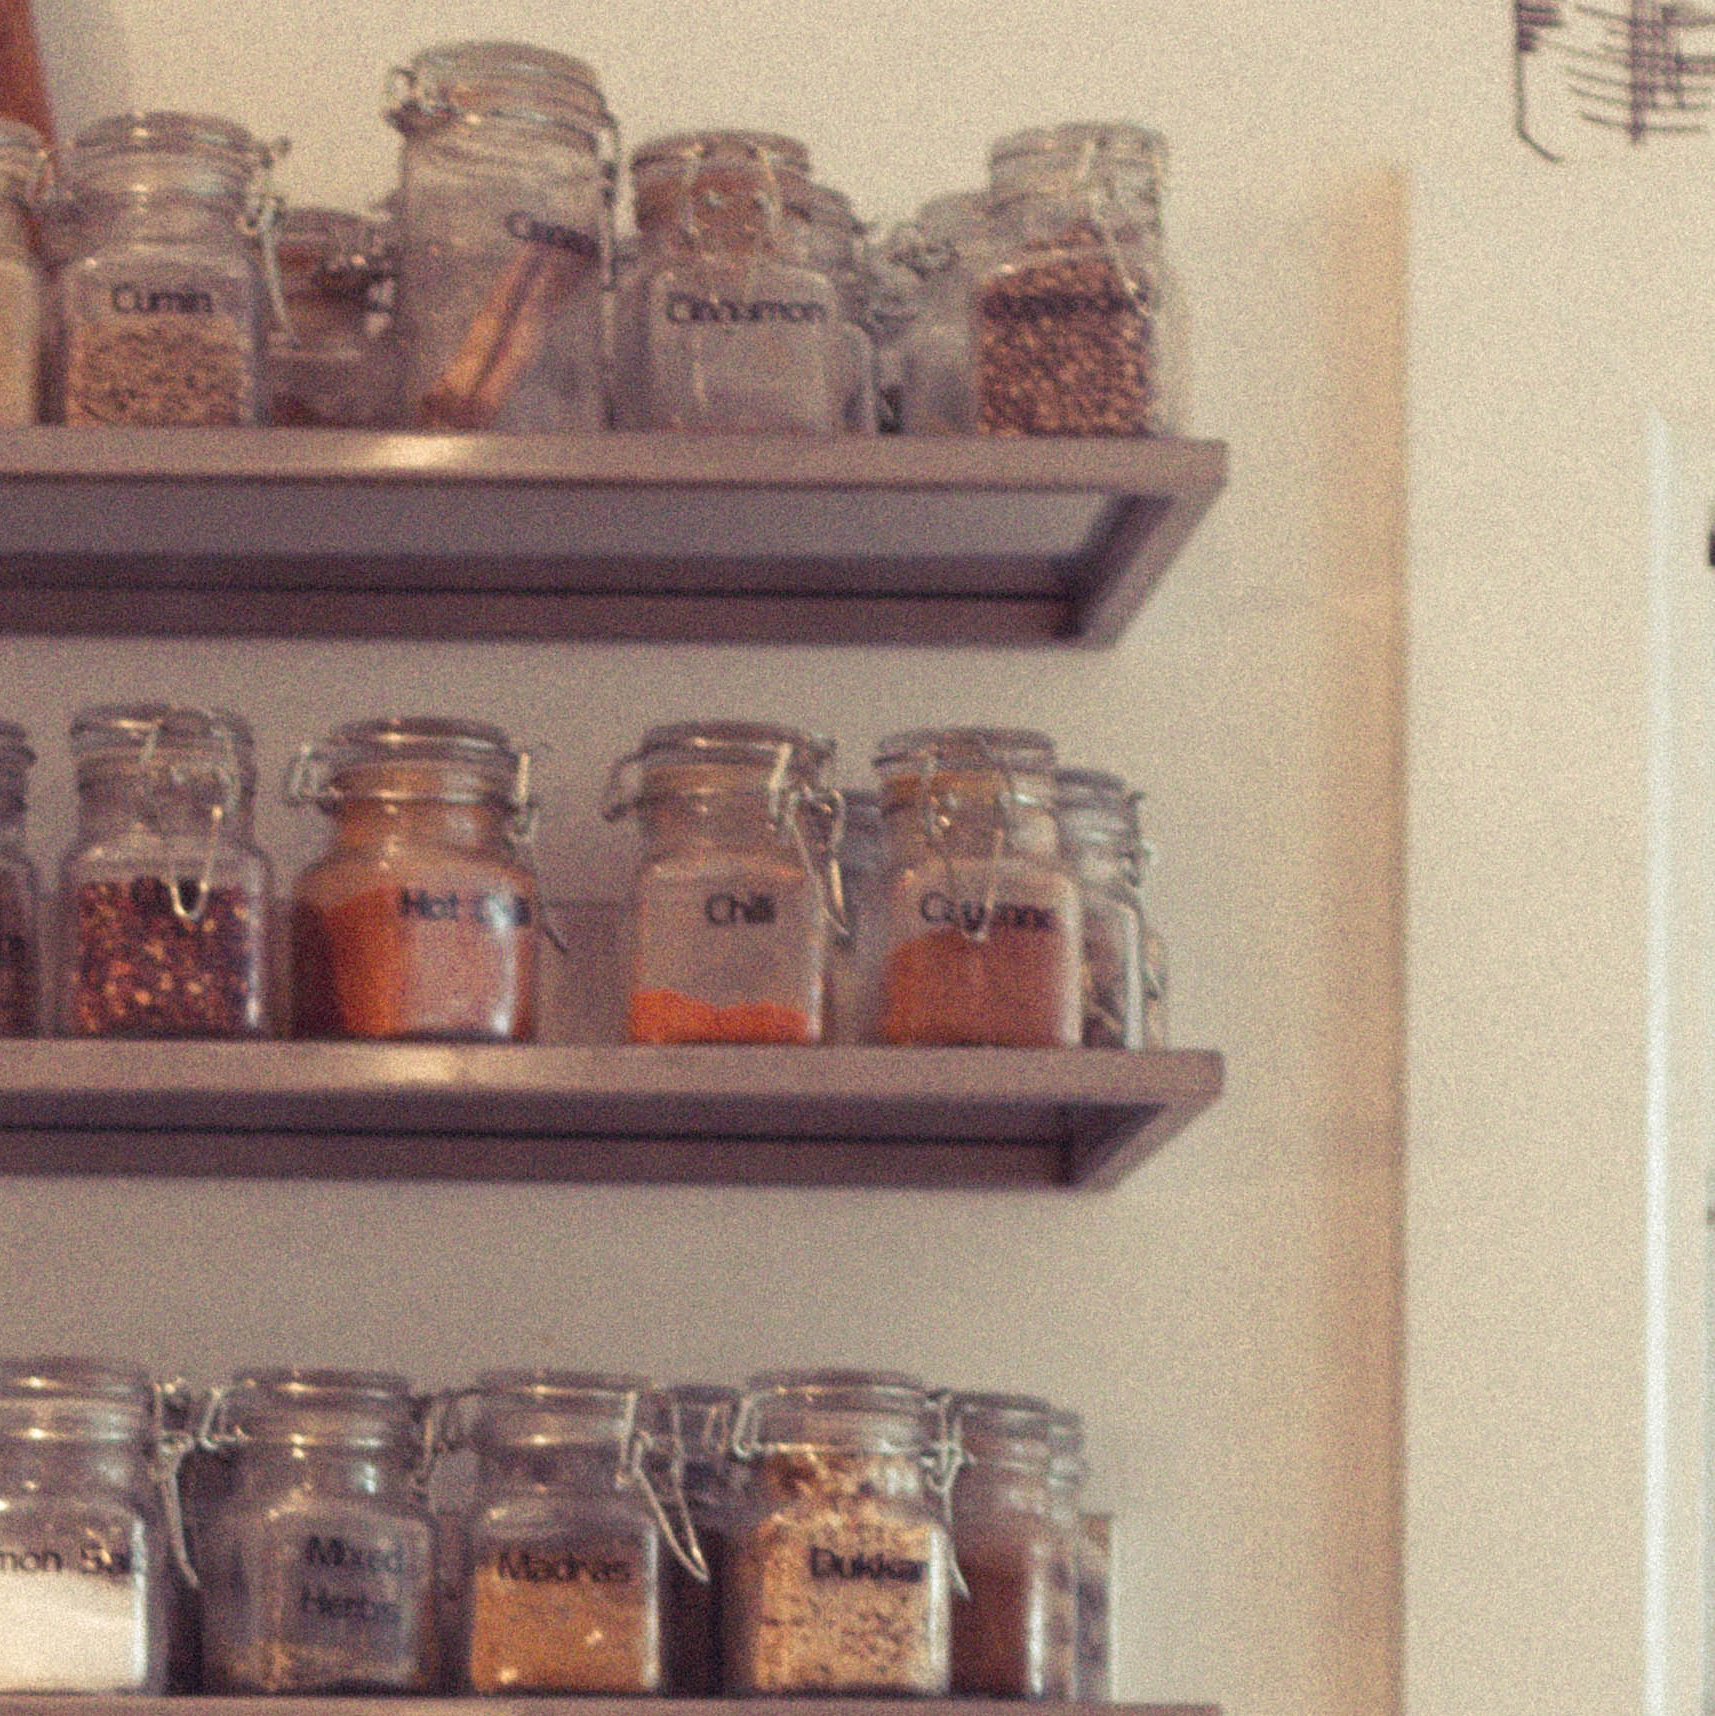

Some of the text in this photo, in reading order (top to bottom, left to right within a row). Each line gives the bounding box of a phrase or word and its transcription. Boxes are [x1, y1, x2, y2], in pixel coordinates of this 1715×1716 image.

[110, 281, 215, 315] Cumin
[665, 292, 828, 324] Cinnamon
[397, 887, 458, 920] Hot
[703, 892, 777, 927] Chilli
[304, 1534, 404, 1568] Mixed
[494, 1547, 629, 1583] Madras
[302, 1583, 398, 1619] Herbs
